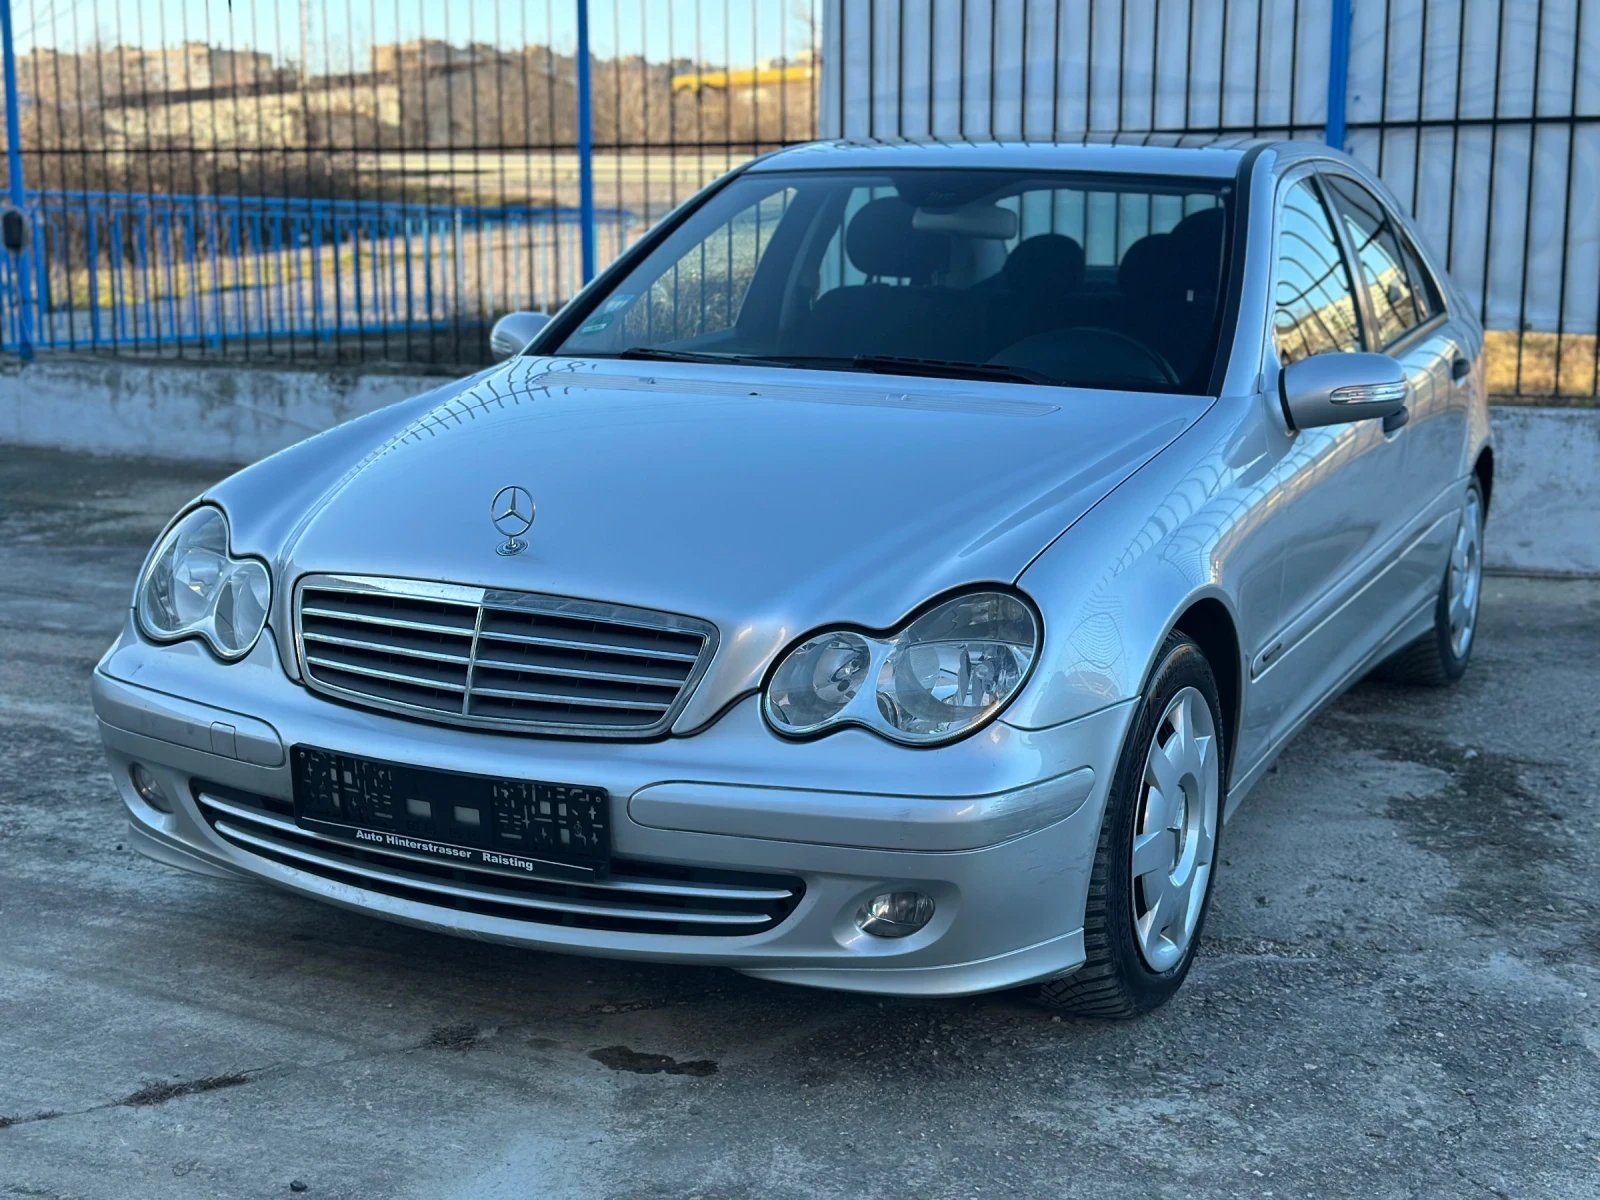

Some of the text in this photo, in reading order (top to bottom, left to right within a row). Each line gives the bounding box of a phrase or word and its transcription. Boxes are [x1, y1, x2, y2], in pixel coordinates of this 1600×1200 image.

[356, 829, 534, 871] Auto Hinterstrasser Raisting
